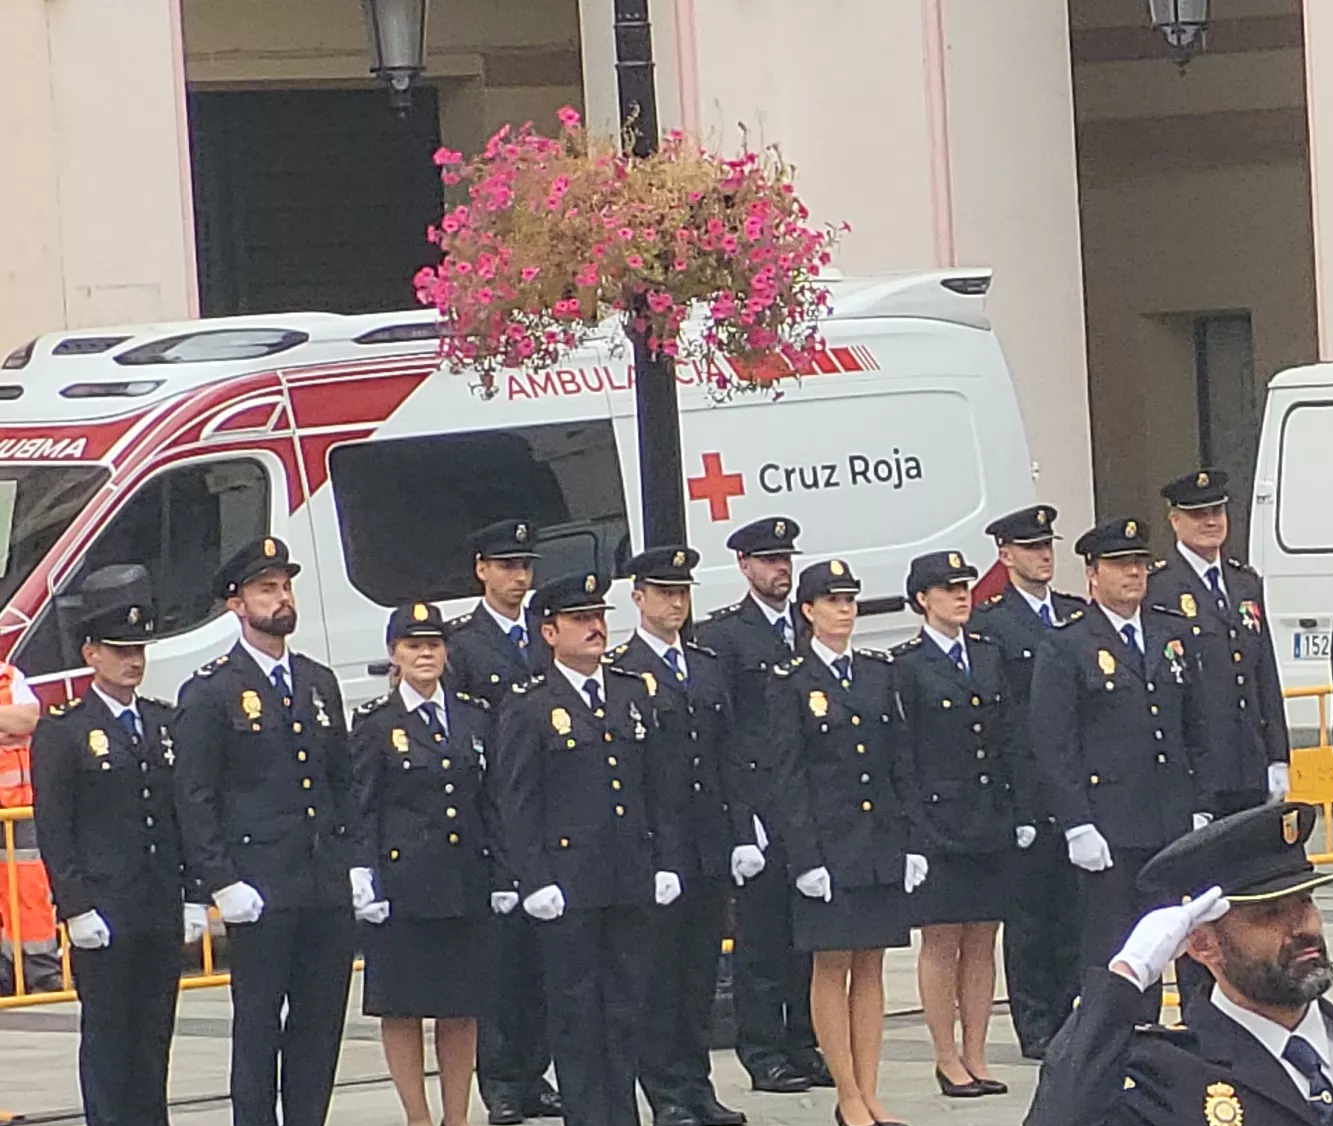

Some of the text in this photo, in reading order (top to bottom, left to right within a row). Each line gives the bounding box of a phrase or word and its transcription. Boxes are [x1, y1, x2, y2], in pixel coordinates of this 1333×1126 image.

[507, 352, 730, 401] AMBULCIA
[759, 447, 922, 494] Cruz Roja
